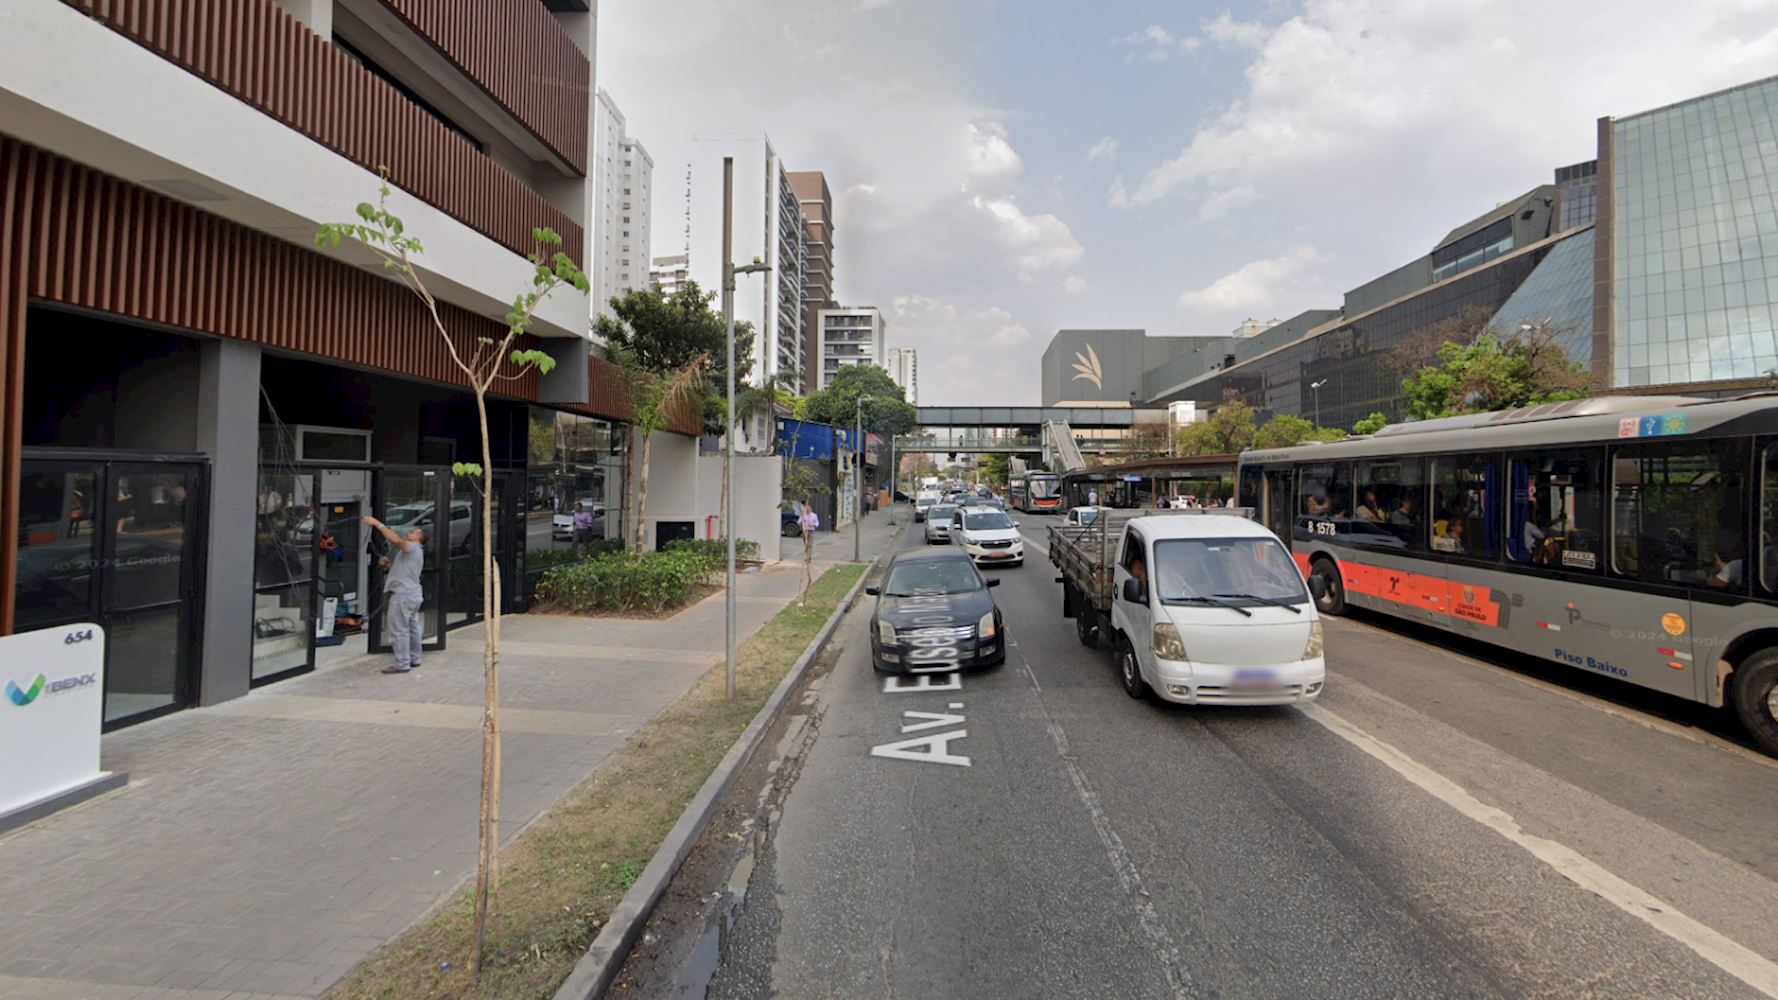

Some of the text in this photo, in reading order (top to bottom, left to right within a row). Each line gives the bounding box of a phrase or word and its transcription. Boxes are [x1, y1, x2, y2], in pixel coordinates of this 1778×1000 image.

[1307, 520, 1337, 537] 8 1578
[64, 629, 93, 645] 654
[1554, 647, 1629, 679] Piso Baixo
